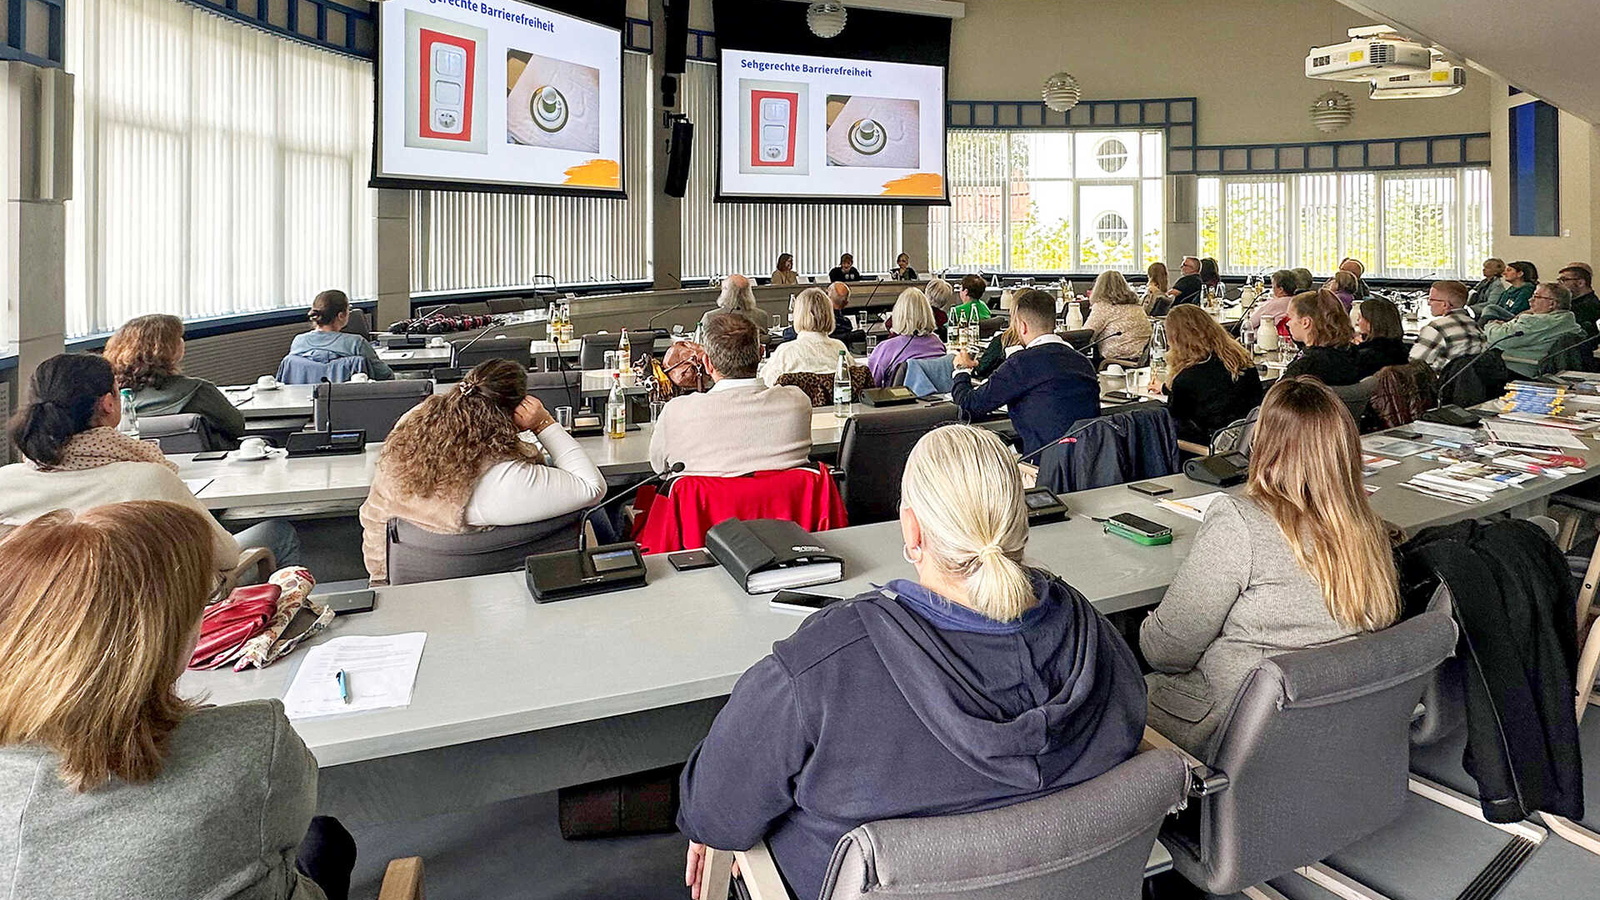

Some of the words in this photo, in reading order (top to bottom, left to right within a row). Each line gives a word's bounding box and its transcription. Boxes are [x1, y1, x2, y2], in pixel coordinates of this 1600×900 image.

[480, 3, 555, 33] Barrierefreiheit
[741, 59, 801, 72] Sehgerechte
[802, 64, 872, 77] Barrierefreiheit
